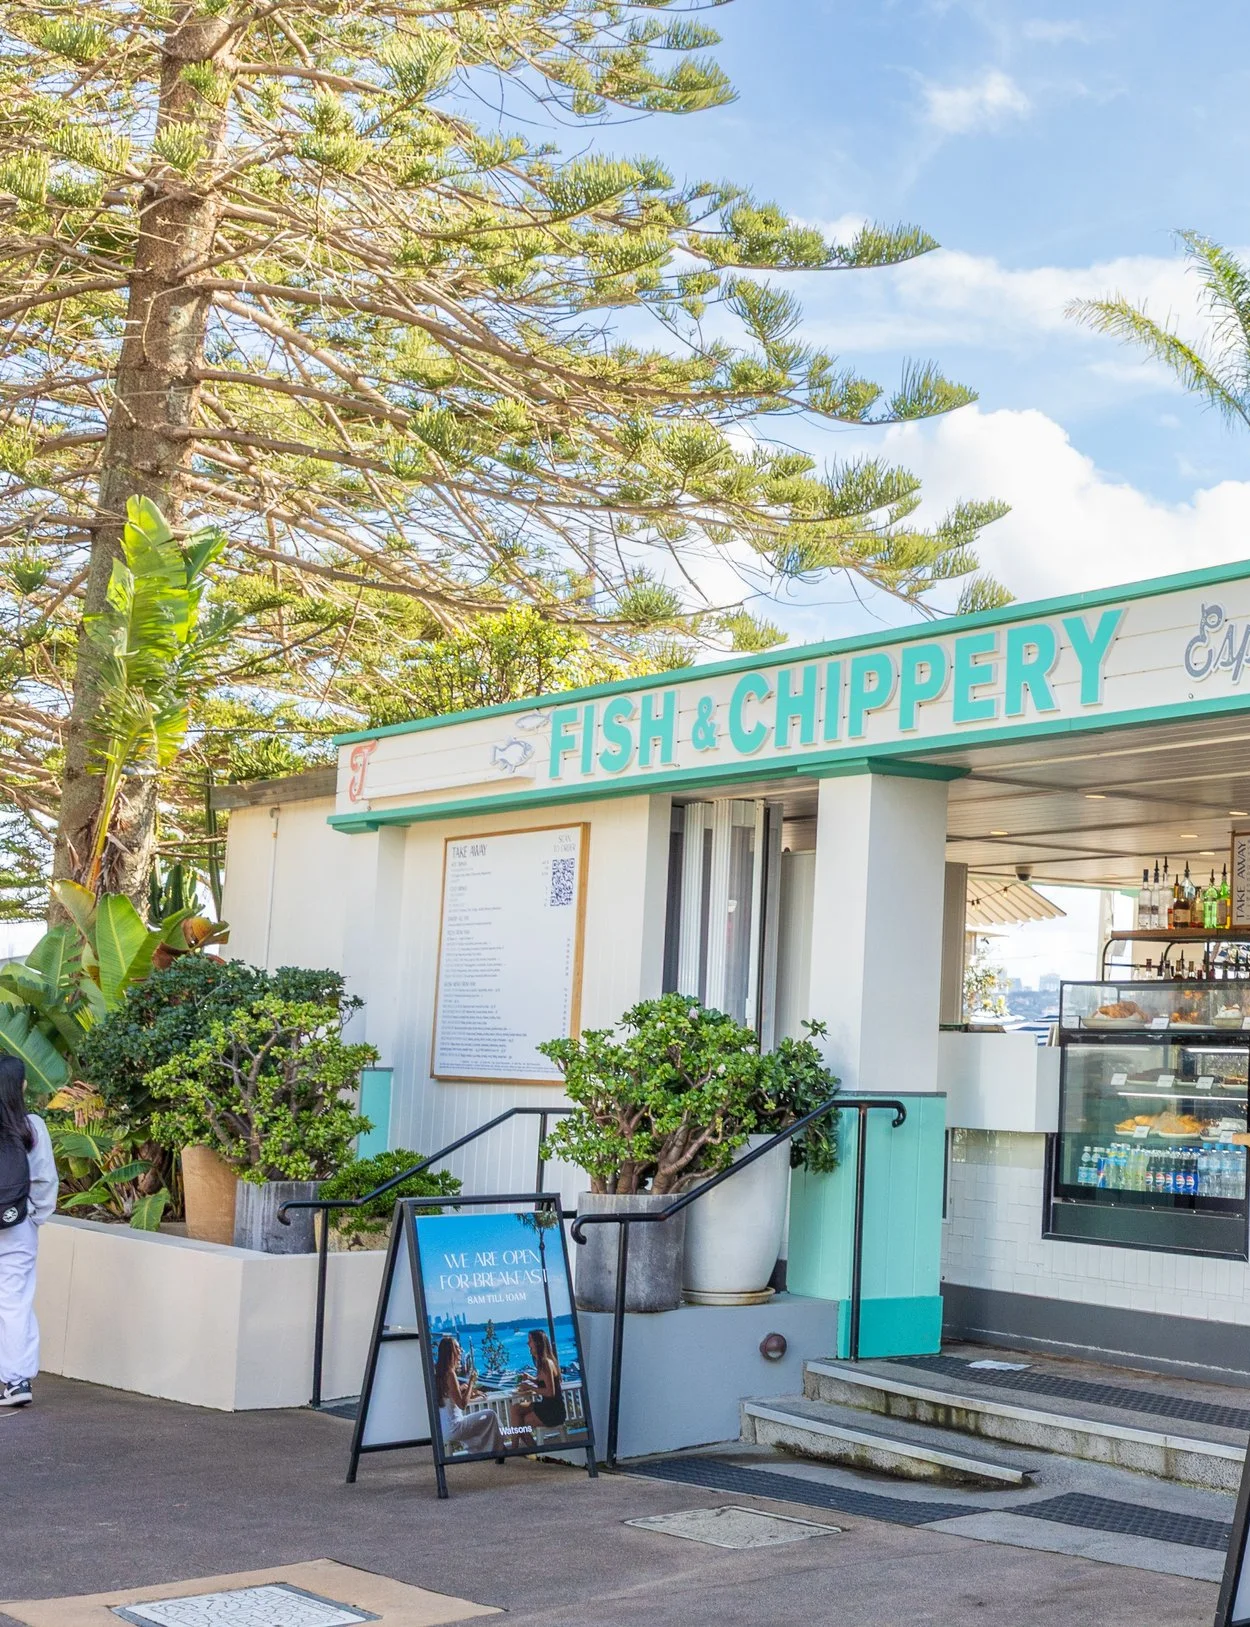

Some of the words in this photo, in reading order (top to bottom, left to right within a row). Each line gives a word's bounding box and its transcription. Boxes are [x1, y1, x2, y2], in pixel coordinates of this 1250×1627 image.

[548, 688, 676, 780] FISH
[691, 694, 718, 751] &
[728, 608, 1125, 755] CHIPPERY
[452, 845, 468, 858] TAKE
[470, 844, 488, 857] AWAY
[1237, 841, 1246, 879] AWAY
[1236, 885, 1245, 918] TAKE
[443, 1251, 468, 1269] WE
[473, 1250, 498, 1267] ARE
[502, 1249, 542, 1265] OPEN
[440, 1272, 472, 1290] FOR
[474, 1268, 548, 1288] BREAKFAST
[467, 1295, 486, 1305] 8AM
[486, 1293, 505, 1303] TILL
[505, 1292, 527, 1303] 10AM
[499, 1424, 533, 1436] Watsons
